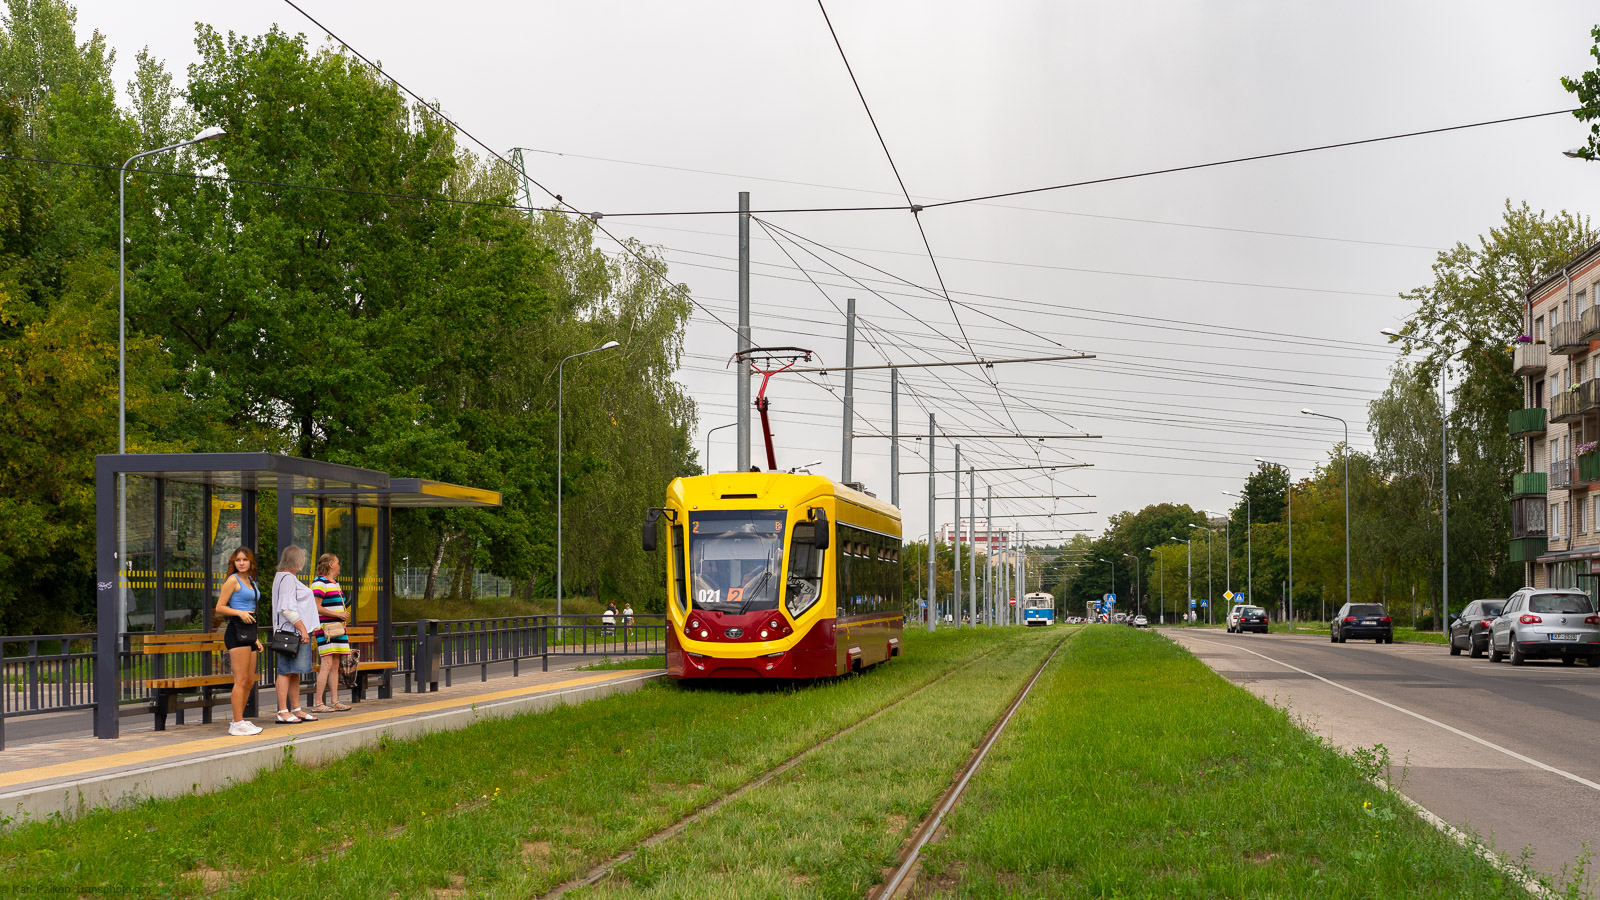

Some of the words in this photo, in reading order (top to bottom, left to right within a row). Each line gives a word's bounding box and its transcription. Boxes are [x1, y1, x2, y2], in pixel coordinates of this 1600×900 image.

[692, 521, 699, 533] 2
[699, 589, 721, 603] 021
[731, 590, 741, 603] 2
